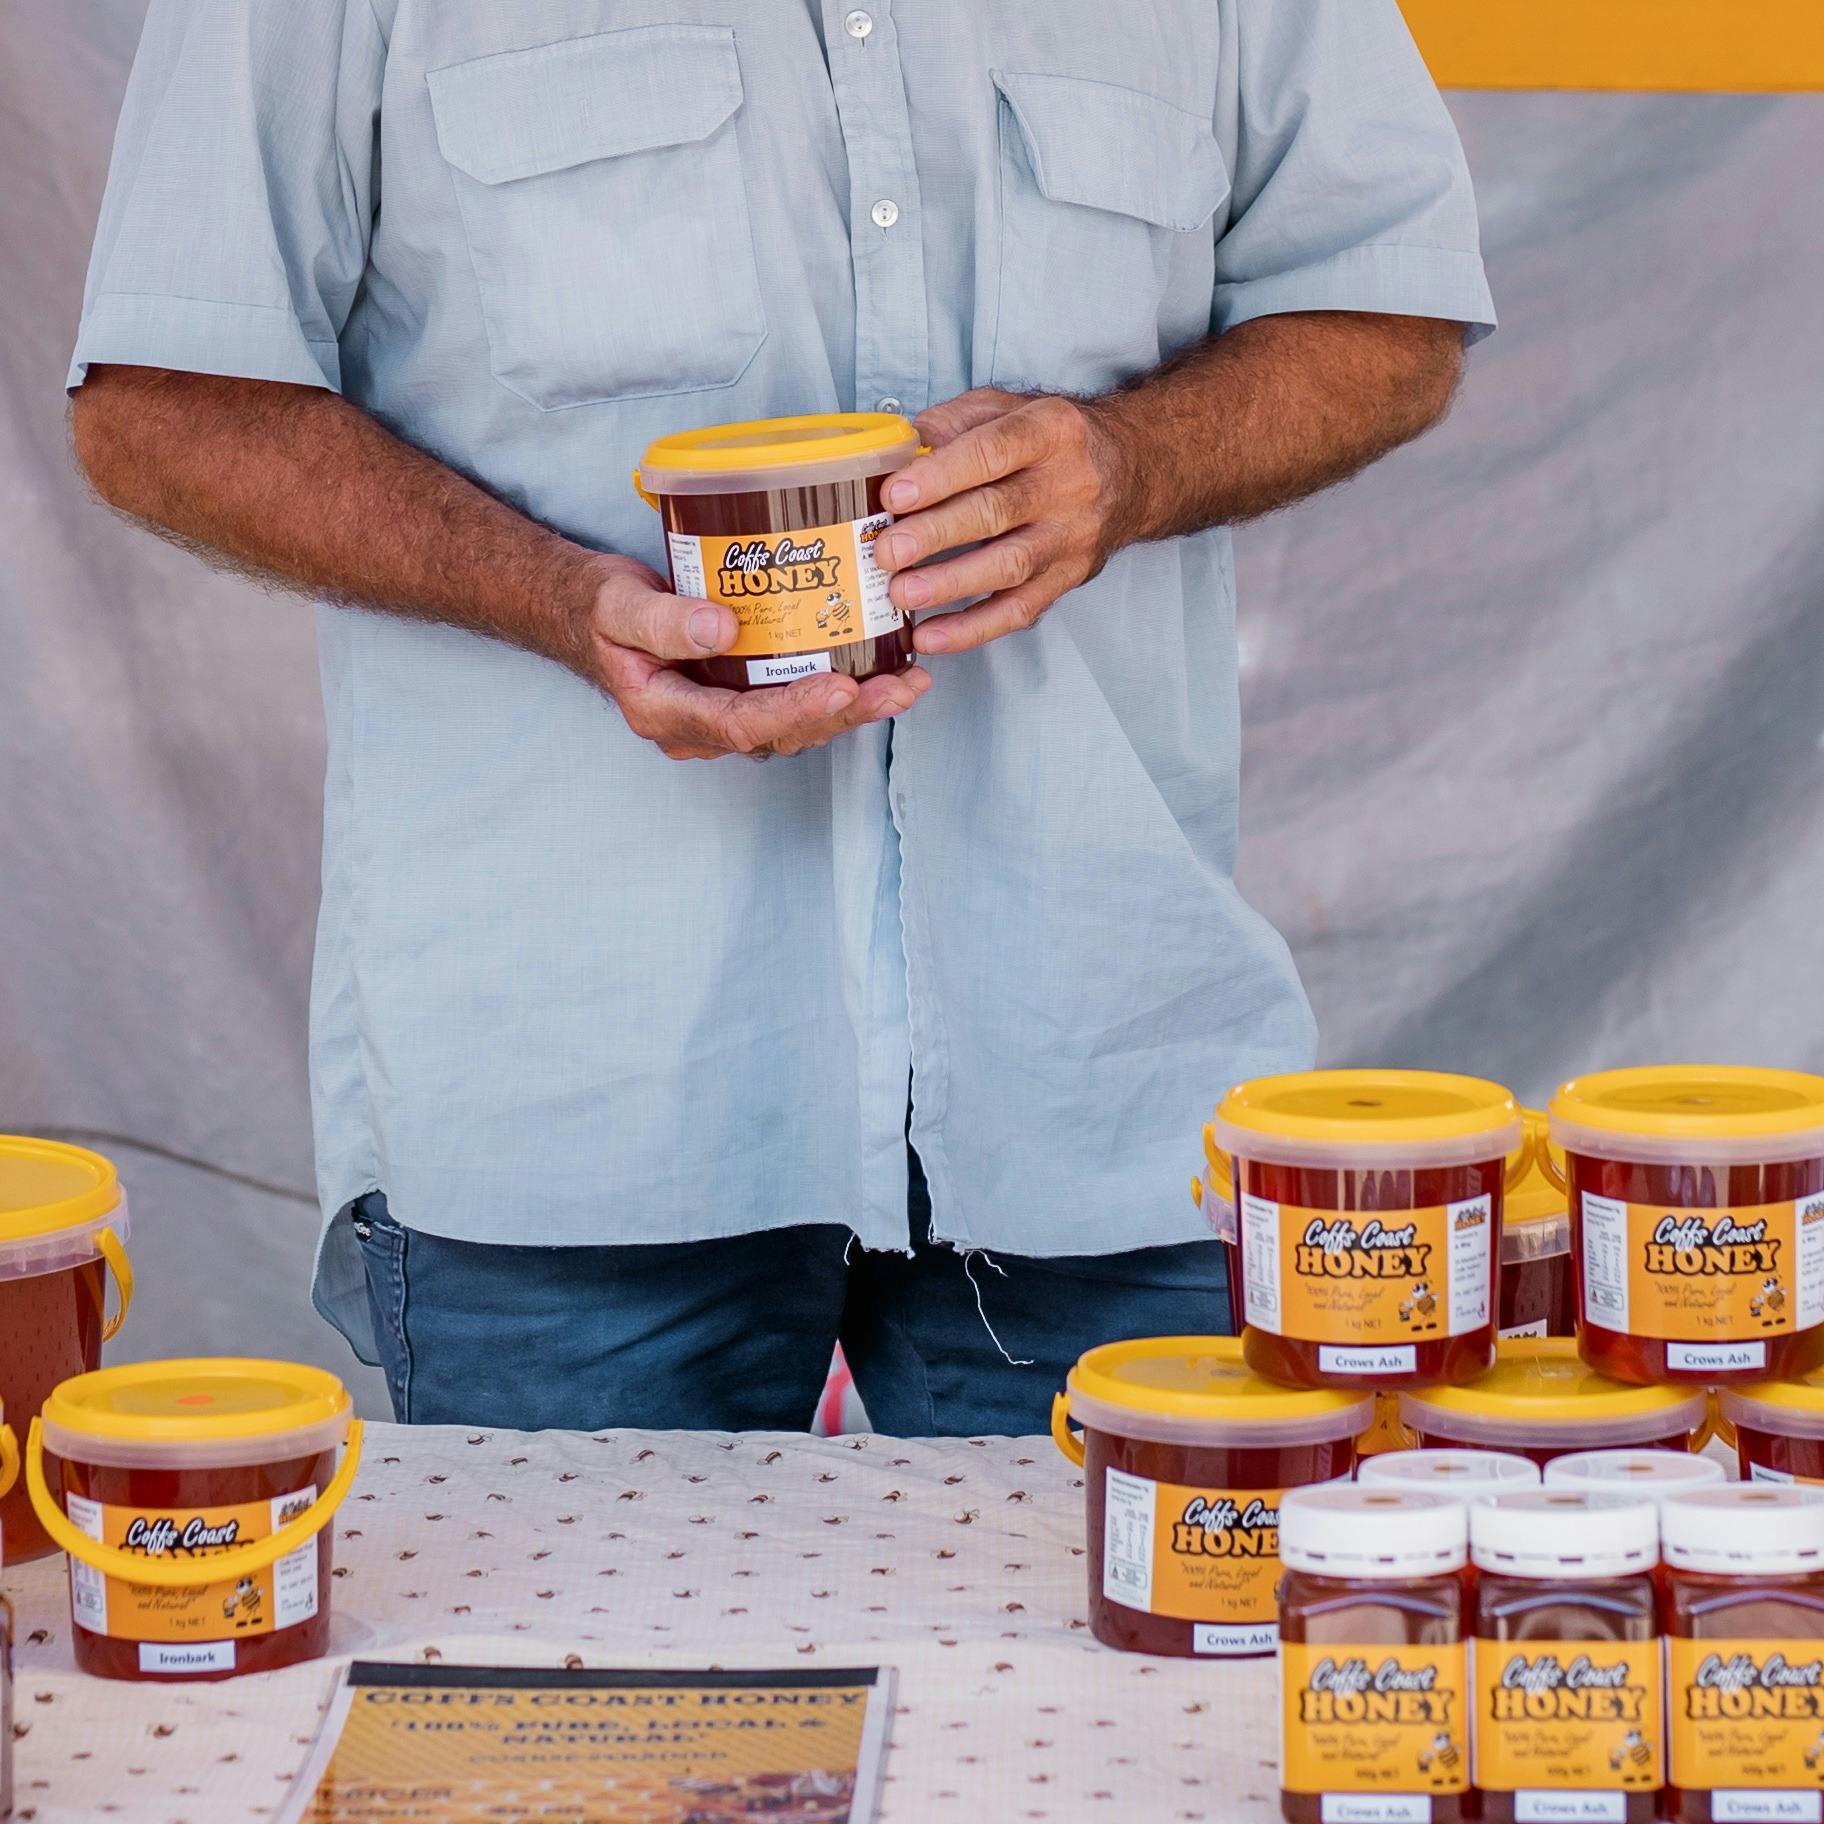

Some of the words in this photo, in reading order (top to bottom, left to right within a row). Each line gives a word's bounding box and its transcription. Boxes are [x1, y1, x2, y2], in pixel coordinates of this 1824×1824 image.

[725, 543, 770, 574] Coffs
[774, 538, 824, 565] Coast
[719, 557, 841, 597] HONEY
[775, 631, 784, 642] kg
[786, 628, 802, 638] NET
[765, 662, 817, 677] Ironbark
[1304, 1219, 1356, 1256] Coffs
[1360, 1219, 1416, 1249] Coast
[1655, 1216, 1708, 1253] Coffs
[1711, 1216, 1767, 1247] Coast
[1296, 1244, 1431, 1278] HONEY
[1645, 1239, 1781, 1275] HONEY
[1335, 1357, 1375, 1369] Crows
[1379, 1356, 1403, 1368] Ash
[1684, 1354, 1725, 1366] Crows
[1727, 1353, 1752, 1365] Ash
[1183, 1497, 1238, 1534] Coffs
[1241, 1498, 1280, 1528] Coas
[127, 1518, 180, 1554] Coffs
[181, 1517, 239, 1548] Coast
[1173, 1523, 1281, 1558] HONE
[1207, 1633, 1246, 1646] Crows
[1249, 1632, 1273, 1645] Ash
[159, 1651, 216, 1665] Ironbark
[530, 1691, 686, 1707] COAST
[699, 1691, 863, 1708] HONEY
[1299, 1687, 1455, 1724] HONEY
[1492, 1685, 1646, 1722] HONEY
